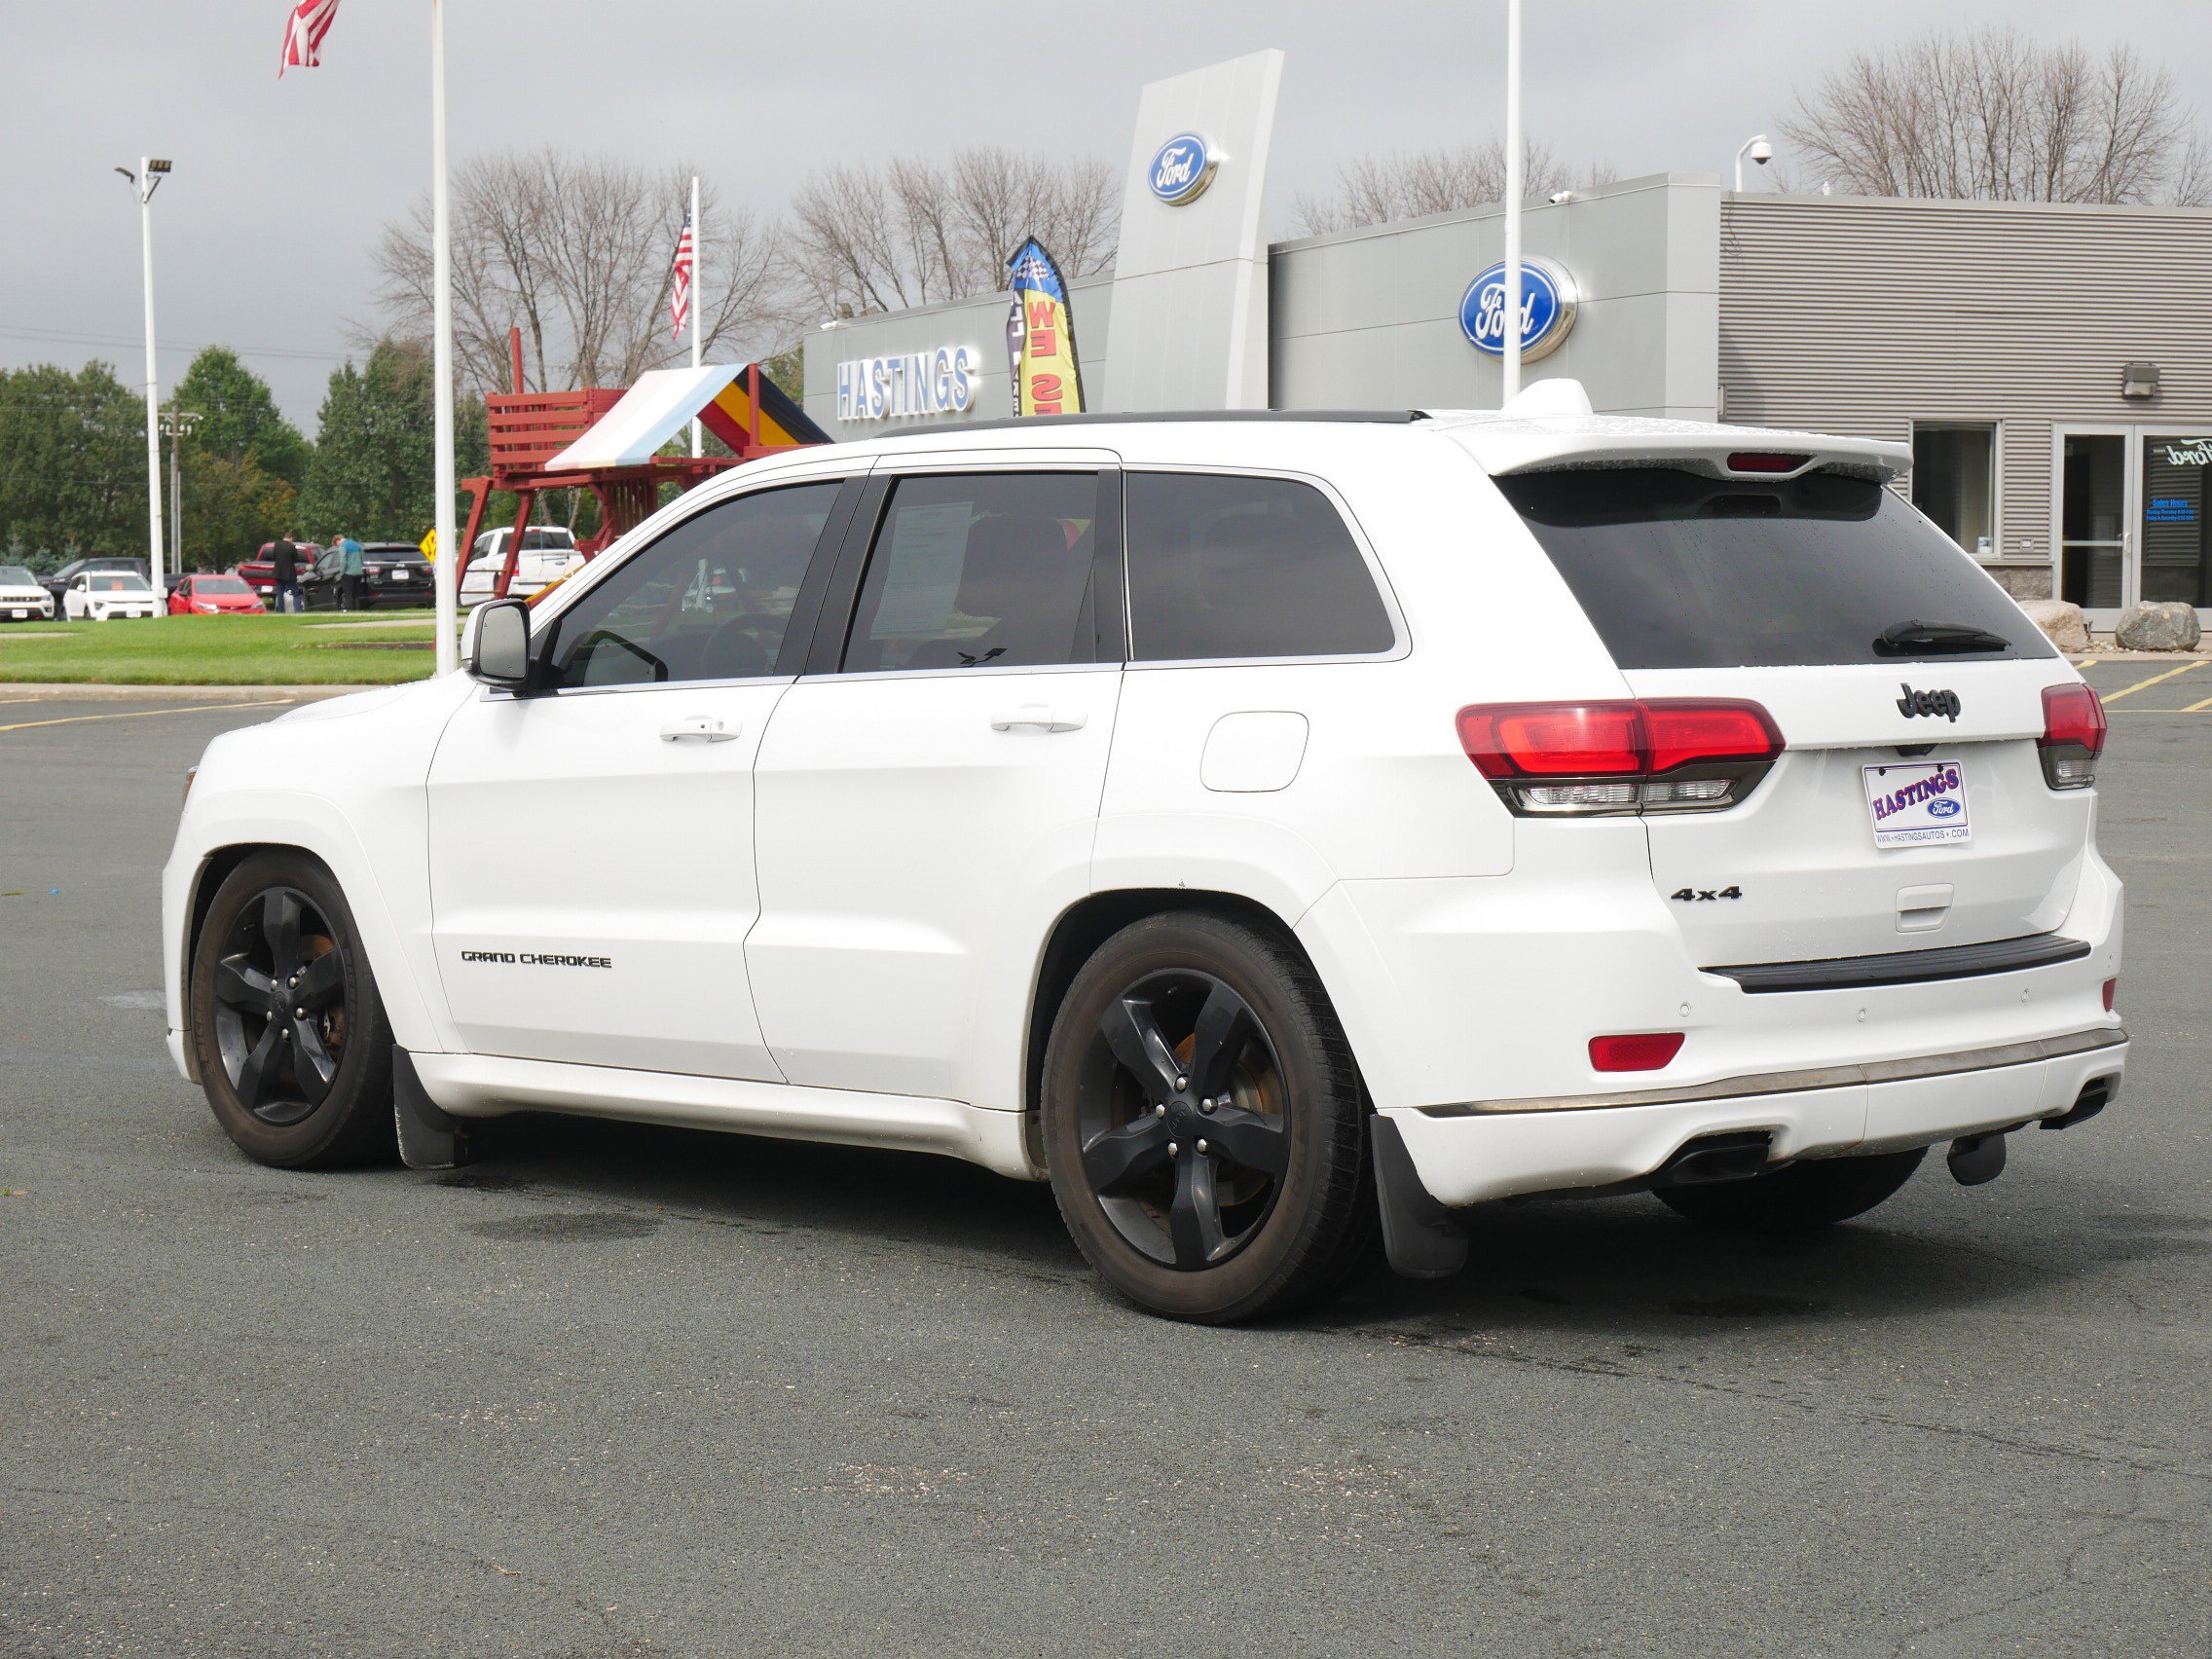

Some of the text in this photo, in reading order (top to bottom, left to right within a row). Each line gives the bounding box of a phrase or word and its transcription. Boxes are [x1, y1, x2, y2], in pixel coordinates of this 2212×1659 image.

[1156, 146, 1195, 188] Ford
[1475, 282, 1536, 339] Fod
[837, 346, 977, 421] HASTINGS
[1896, 682, 1962, 723] Jeep
[1872, 768, 1960, 821] HASTINGS
[1932, 799, 1955, 815] Ford
[1671, 885, 1743, 902] 4x4
[461, 950, 612, 969] GRAND CHEROKEE
